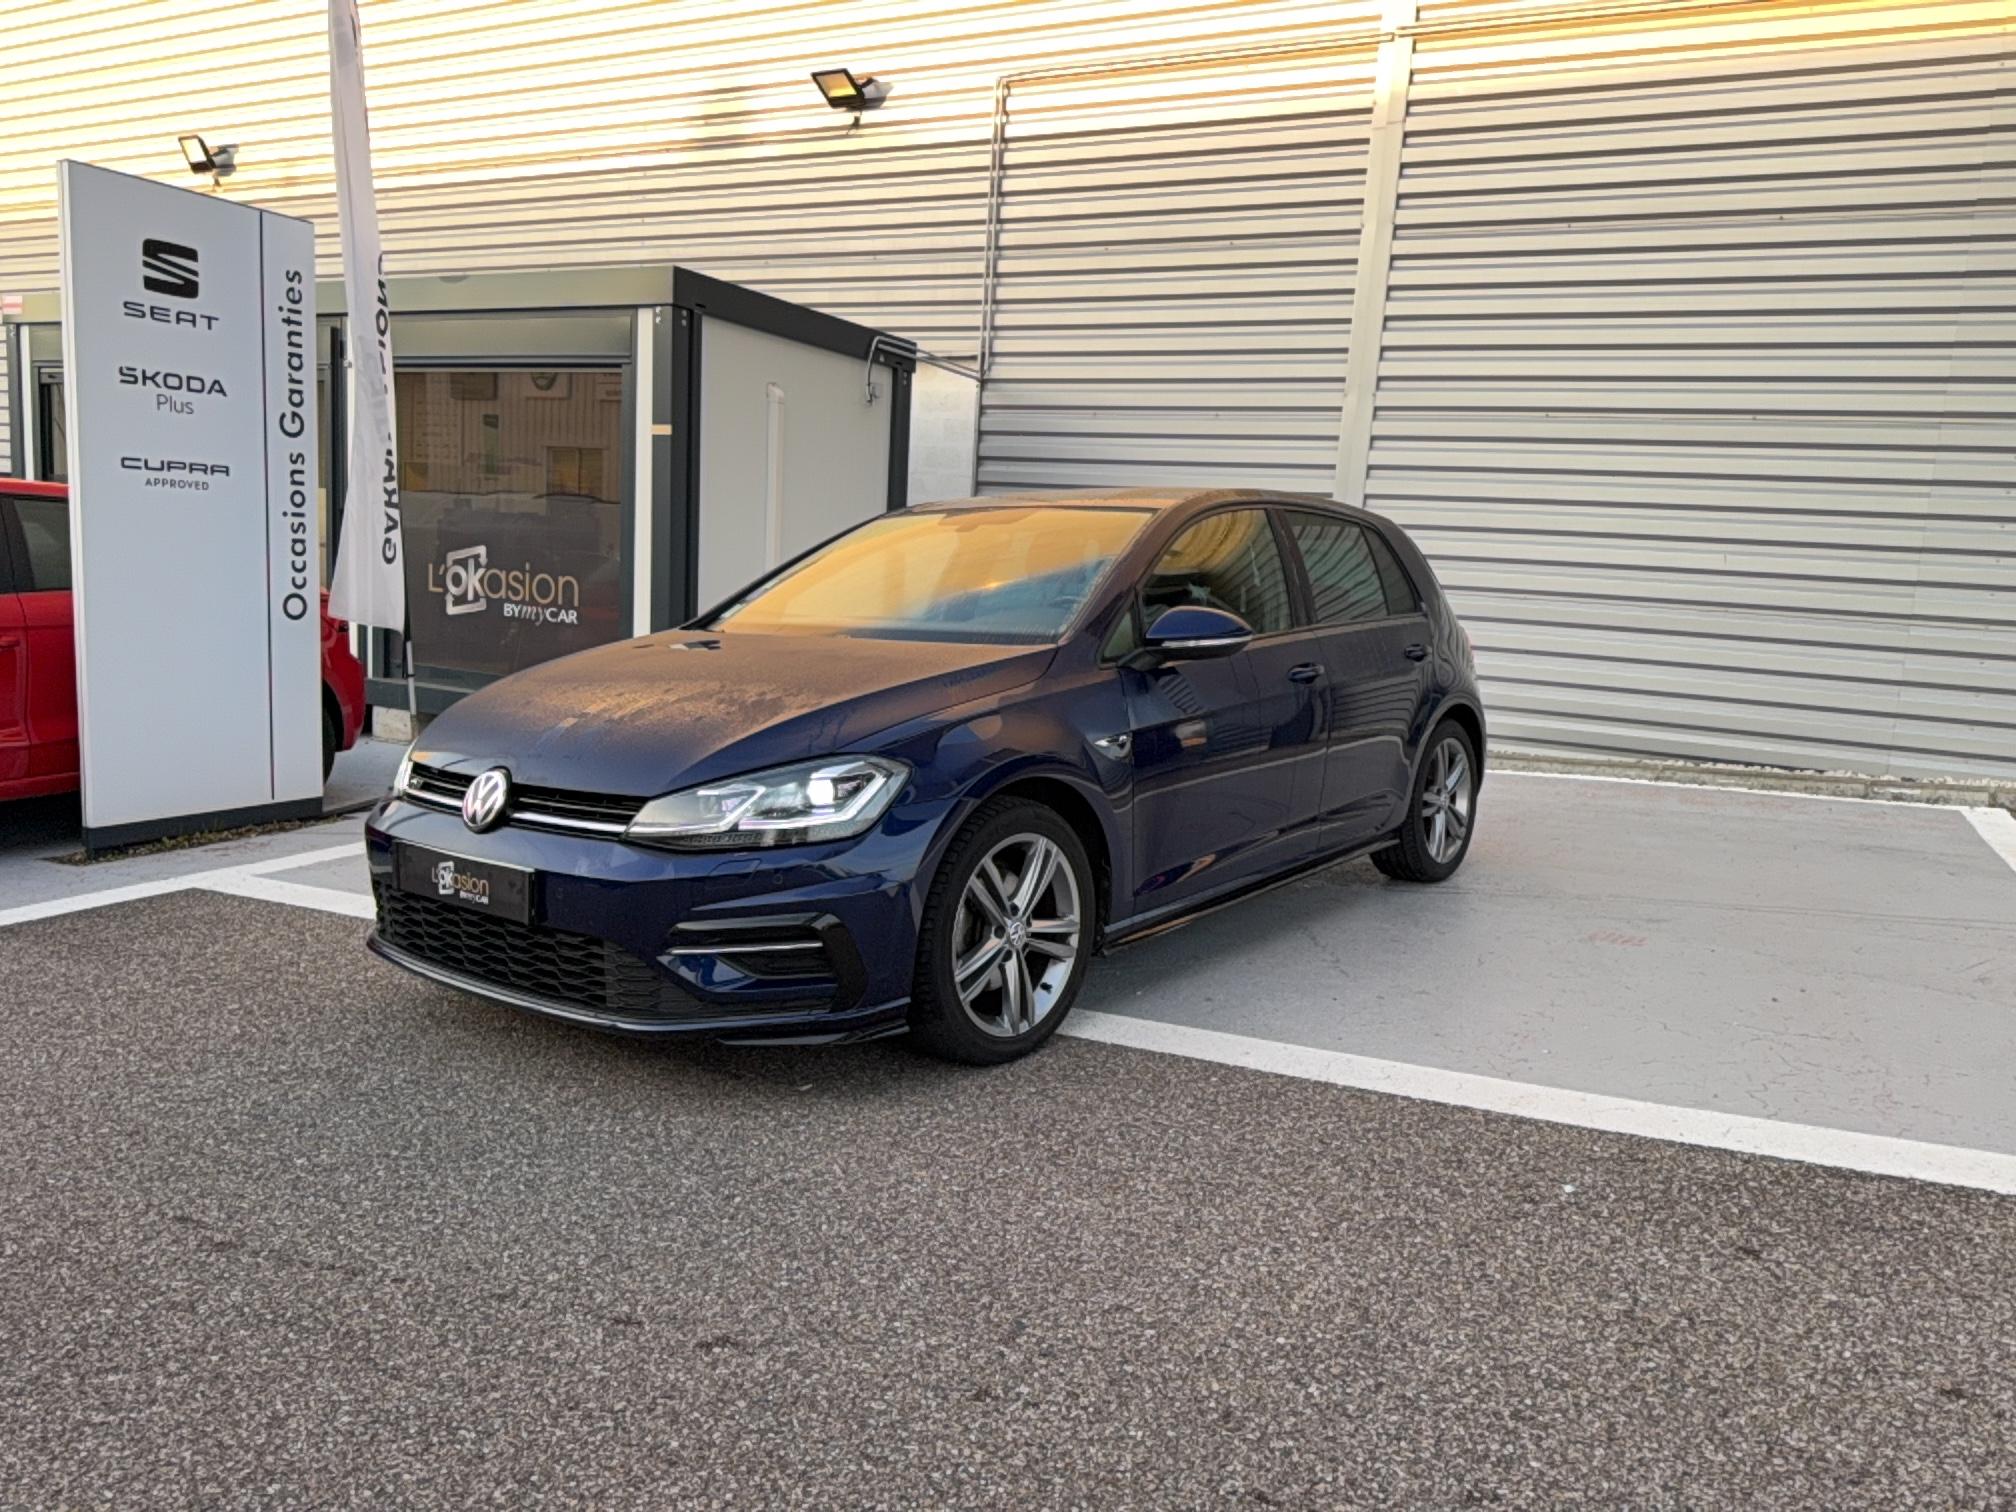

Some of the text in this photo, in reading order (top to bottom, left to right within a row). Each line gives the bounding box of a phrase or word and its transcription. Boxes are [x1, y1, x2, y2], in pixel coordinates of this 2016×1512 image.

[123, 301, 220, 331] SEAT
[156, 393, 195, 415] Plus
[278, 269, 308, 621] Occasions Garanties
[120, 456, 231, 477] CUPRA
[144, 477, 210, 491] APPROVED
